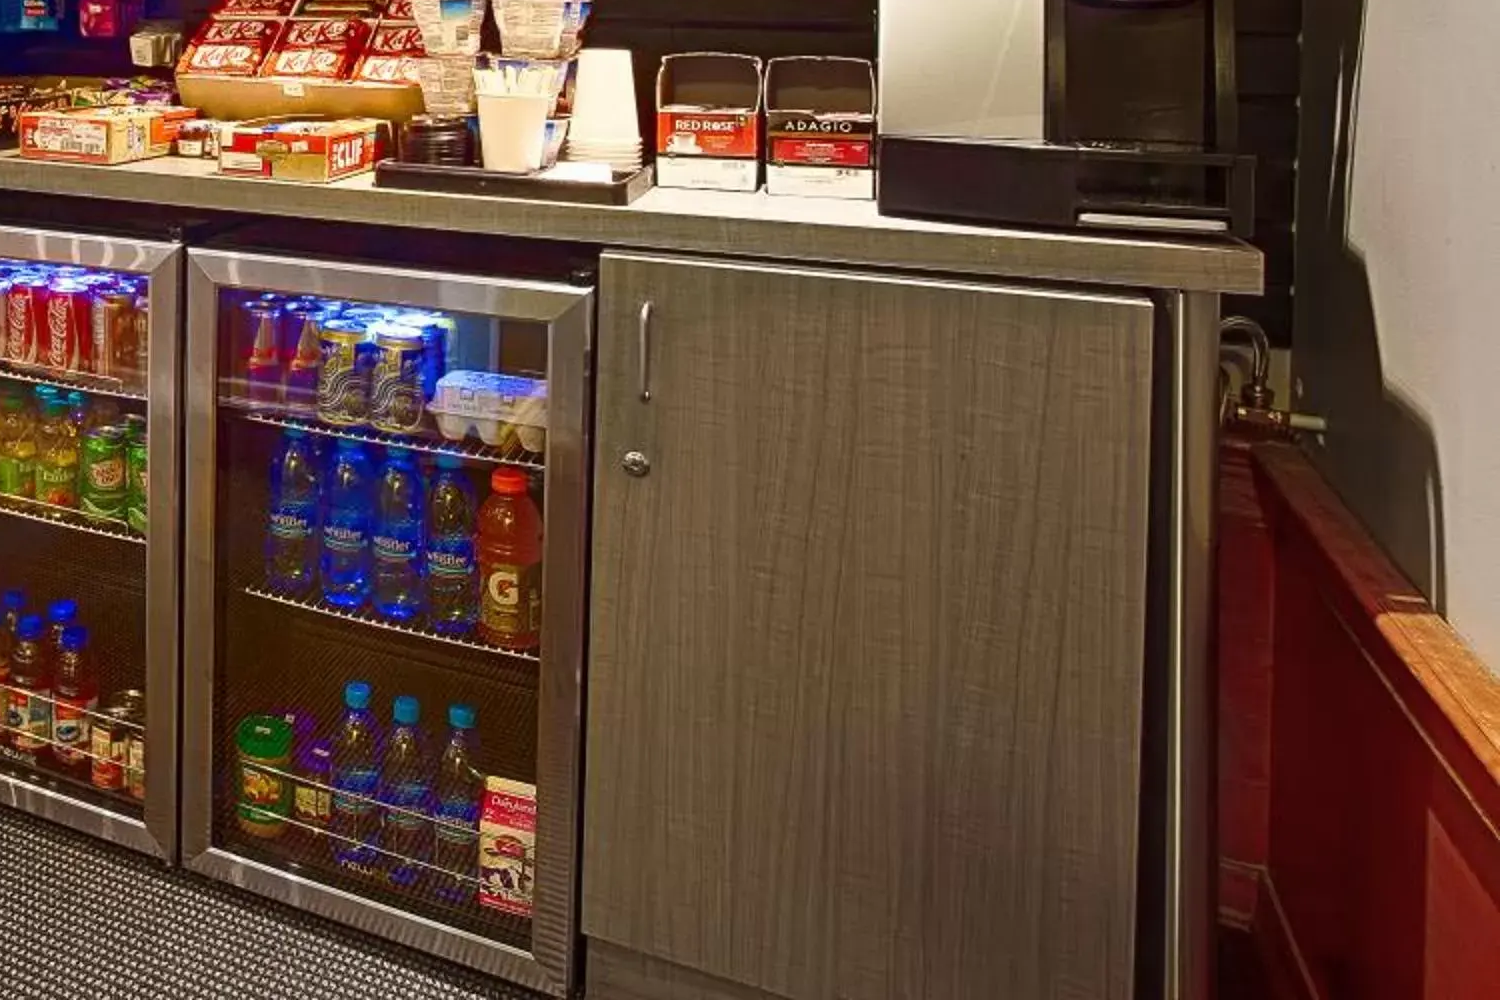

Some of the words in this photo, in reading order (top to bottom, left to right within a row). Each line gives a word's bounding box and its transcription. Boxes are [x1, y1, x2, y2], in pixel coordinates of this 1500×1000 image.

[675, 119, 700, 132] RED
[702, 119, 736, 132] ROSE
[784, 120, 853, 133] ADAGIO
[336, 137, 365, 168] CLIF
[488, 571, 519, 605] G
